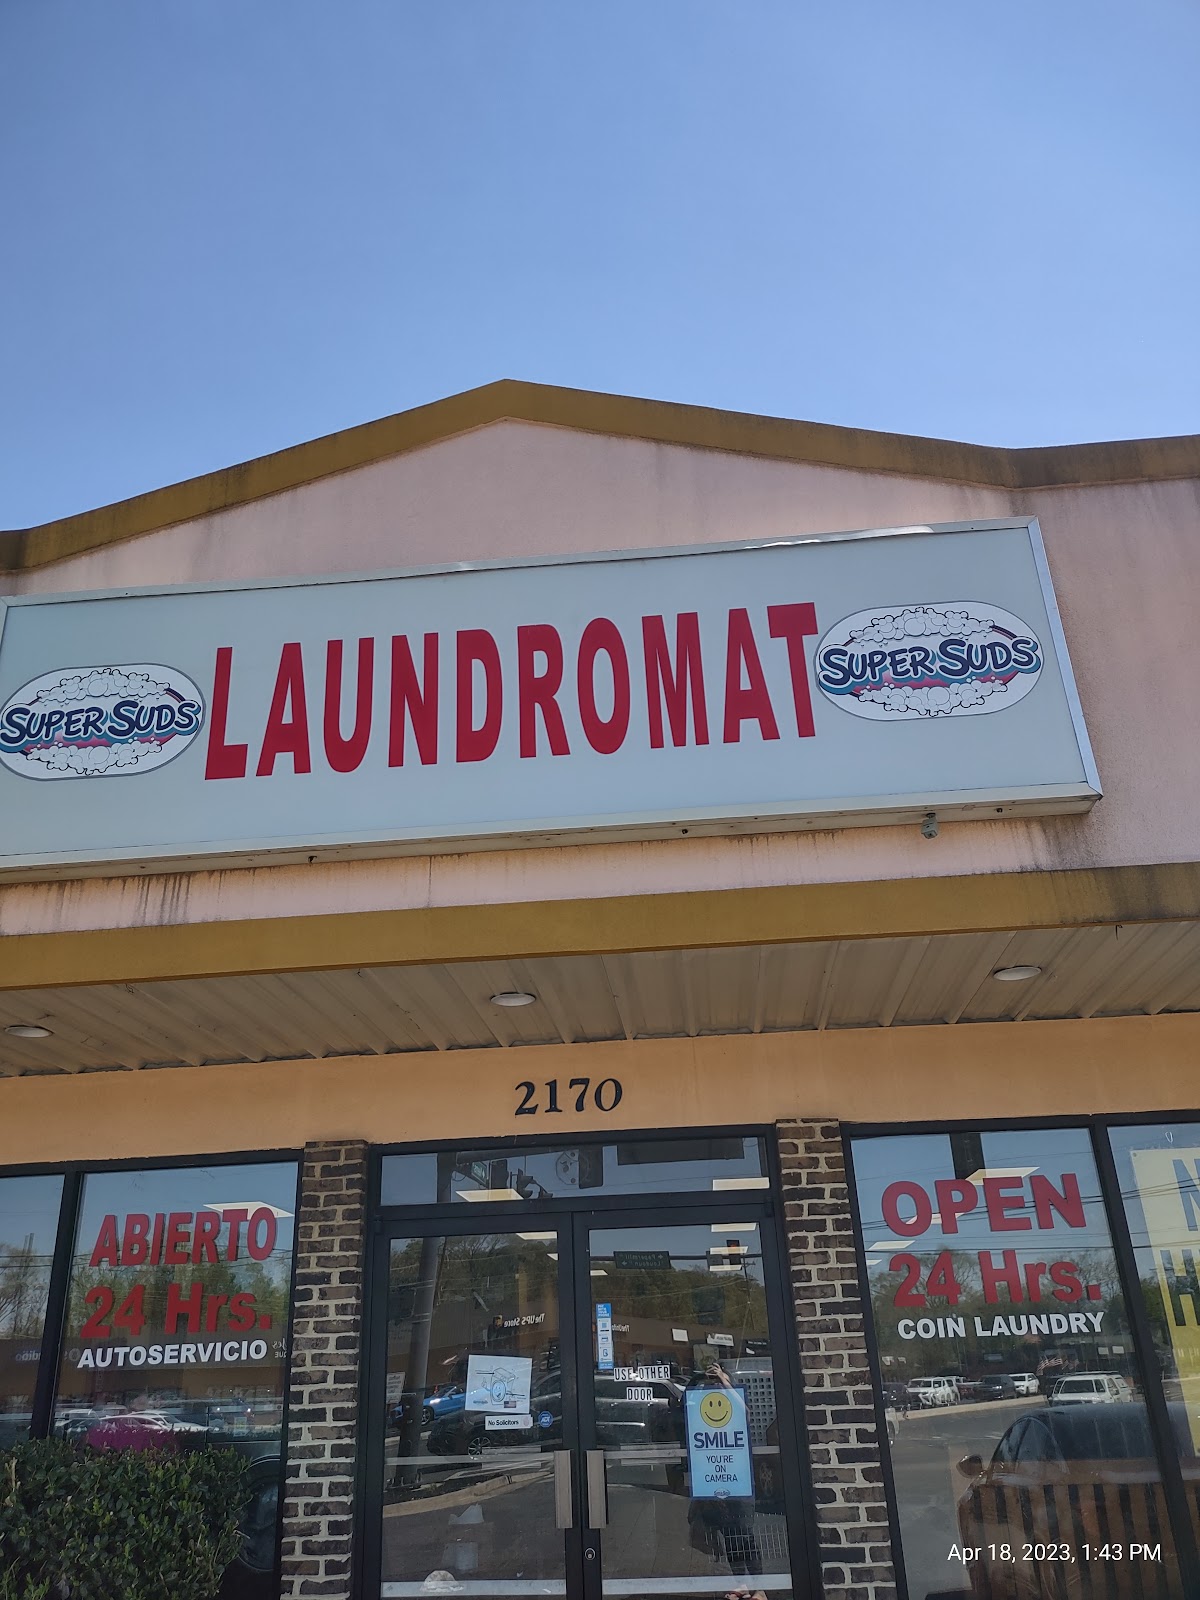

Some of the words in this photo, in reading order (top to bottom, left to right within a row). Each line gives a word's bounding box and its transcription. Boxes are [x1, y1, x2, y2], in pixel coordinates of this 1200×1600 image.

[822, 645, 935, 686] SUPER
[937, 638, 1036, 677] SUDS
[205, 602, 818, 781] LAUNDROMAT
[0, 706, 105, 744] SUPER
[107, 700, 197, 738] SUDS
[514, 1077, 623, 1116] 2170
[881, 1173, 1087, 1237] OPEN
[89, 1206, 279, 1268] ABIERTO
[888, 1251, 963, 1308] 24
[977, 1249, 1102, 1305] Hrs.
[80, 1284, 145, 1339] 24
[164, 1282, 272, 1336] Hrs.
[897, 1316, 966, 1340] COIN
[975, 1312, 1105, 1338] LAUNDRY
[77, 1340, 268, 1368] AUTOSERVICIO
[614, 1368, 633, 1381] USE
[638, 1366, 670, 1380] OTHER
[627, 1388, 652, 1401] DOOR
[693, 1431, 745, 1449] SMILE
[706, 1455, 734, 1464] YOU'RE
[714, 1464, 727, 1473] ON
[704, 1474, 739, 1483] CAMERA
